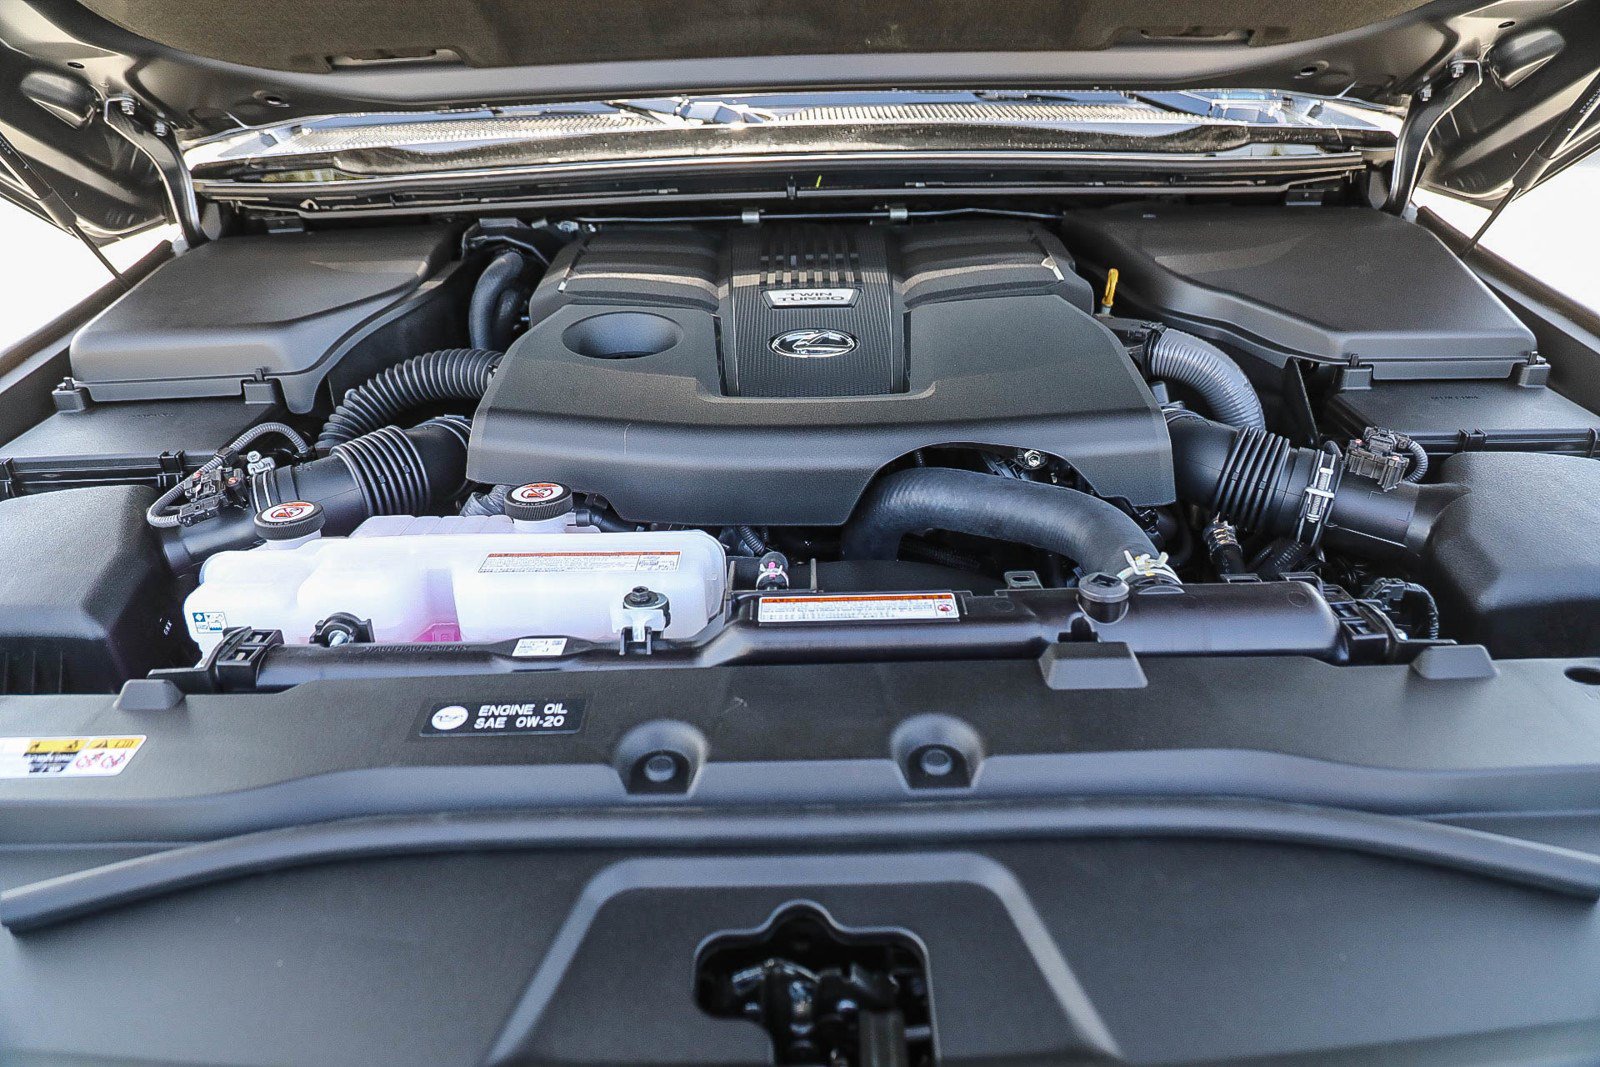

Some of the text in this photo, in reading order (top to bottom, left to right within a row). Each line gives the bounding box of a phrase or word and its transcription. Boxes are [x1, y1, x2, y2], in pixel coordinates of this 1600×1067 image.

[478, 703, 568, 717] ENGINE OIL
[474, 716, 565, 729] SAE 0W-20
